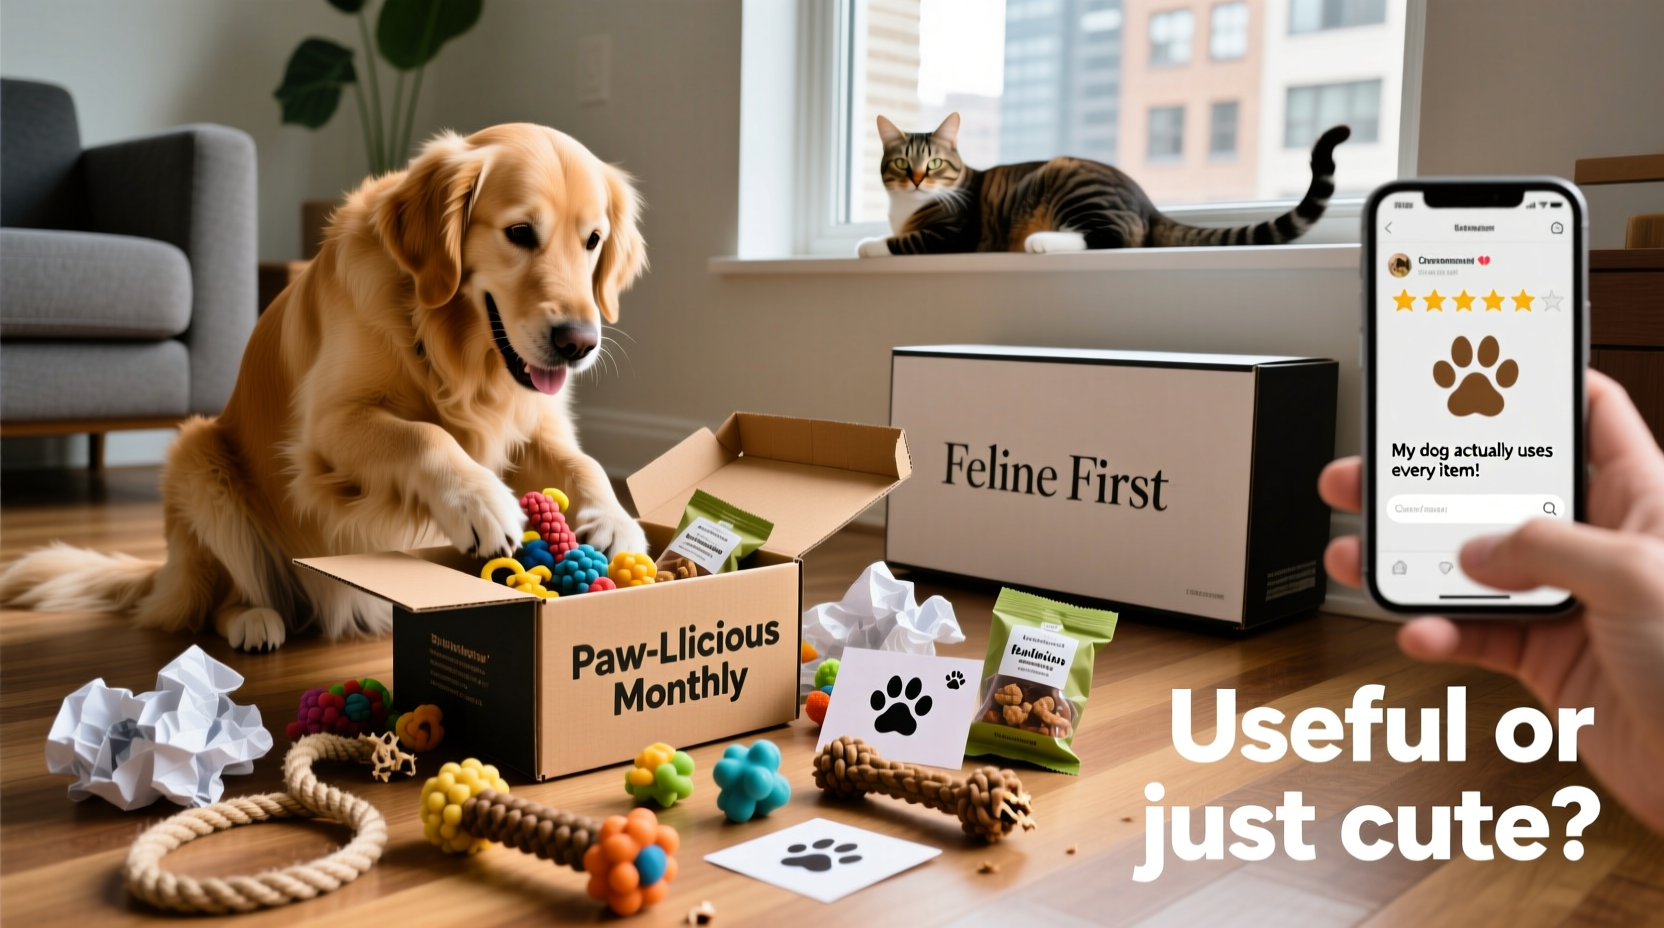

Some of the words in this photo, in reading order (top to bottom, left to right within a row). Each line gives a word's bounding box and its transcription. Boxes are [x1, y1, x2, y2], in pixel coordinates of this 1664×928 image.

[942, 441, 1057, 498] Feline
[1066, 454, 1169, 512] First
[1392, 443, 1415, 460] My
[1420, 442, 1449, 460] dog
[1454, 442, 1513, 460] actually
[1518, 446, 1553, 457] uses
[1392, 465, 1436, 480] every
[1439, 462, 1480, 477] item!
[572, 620, 780, 680] Paw-Llicious
[614, 661, 748, 716] Monthly
